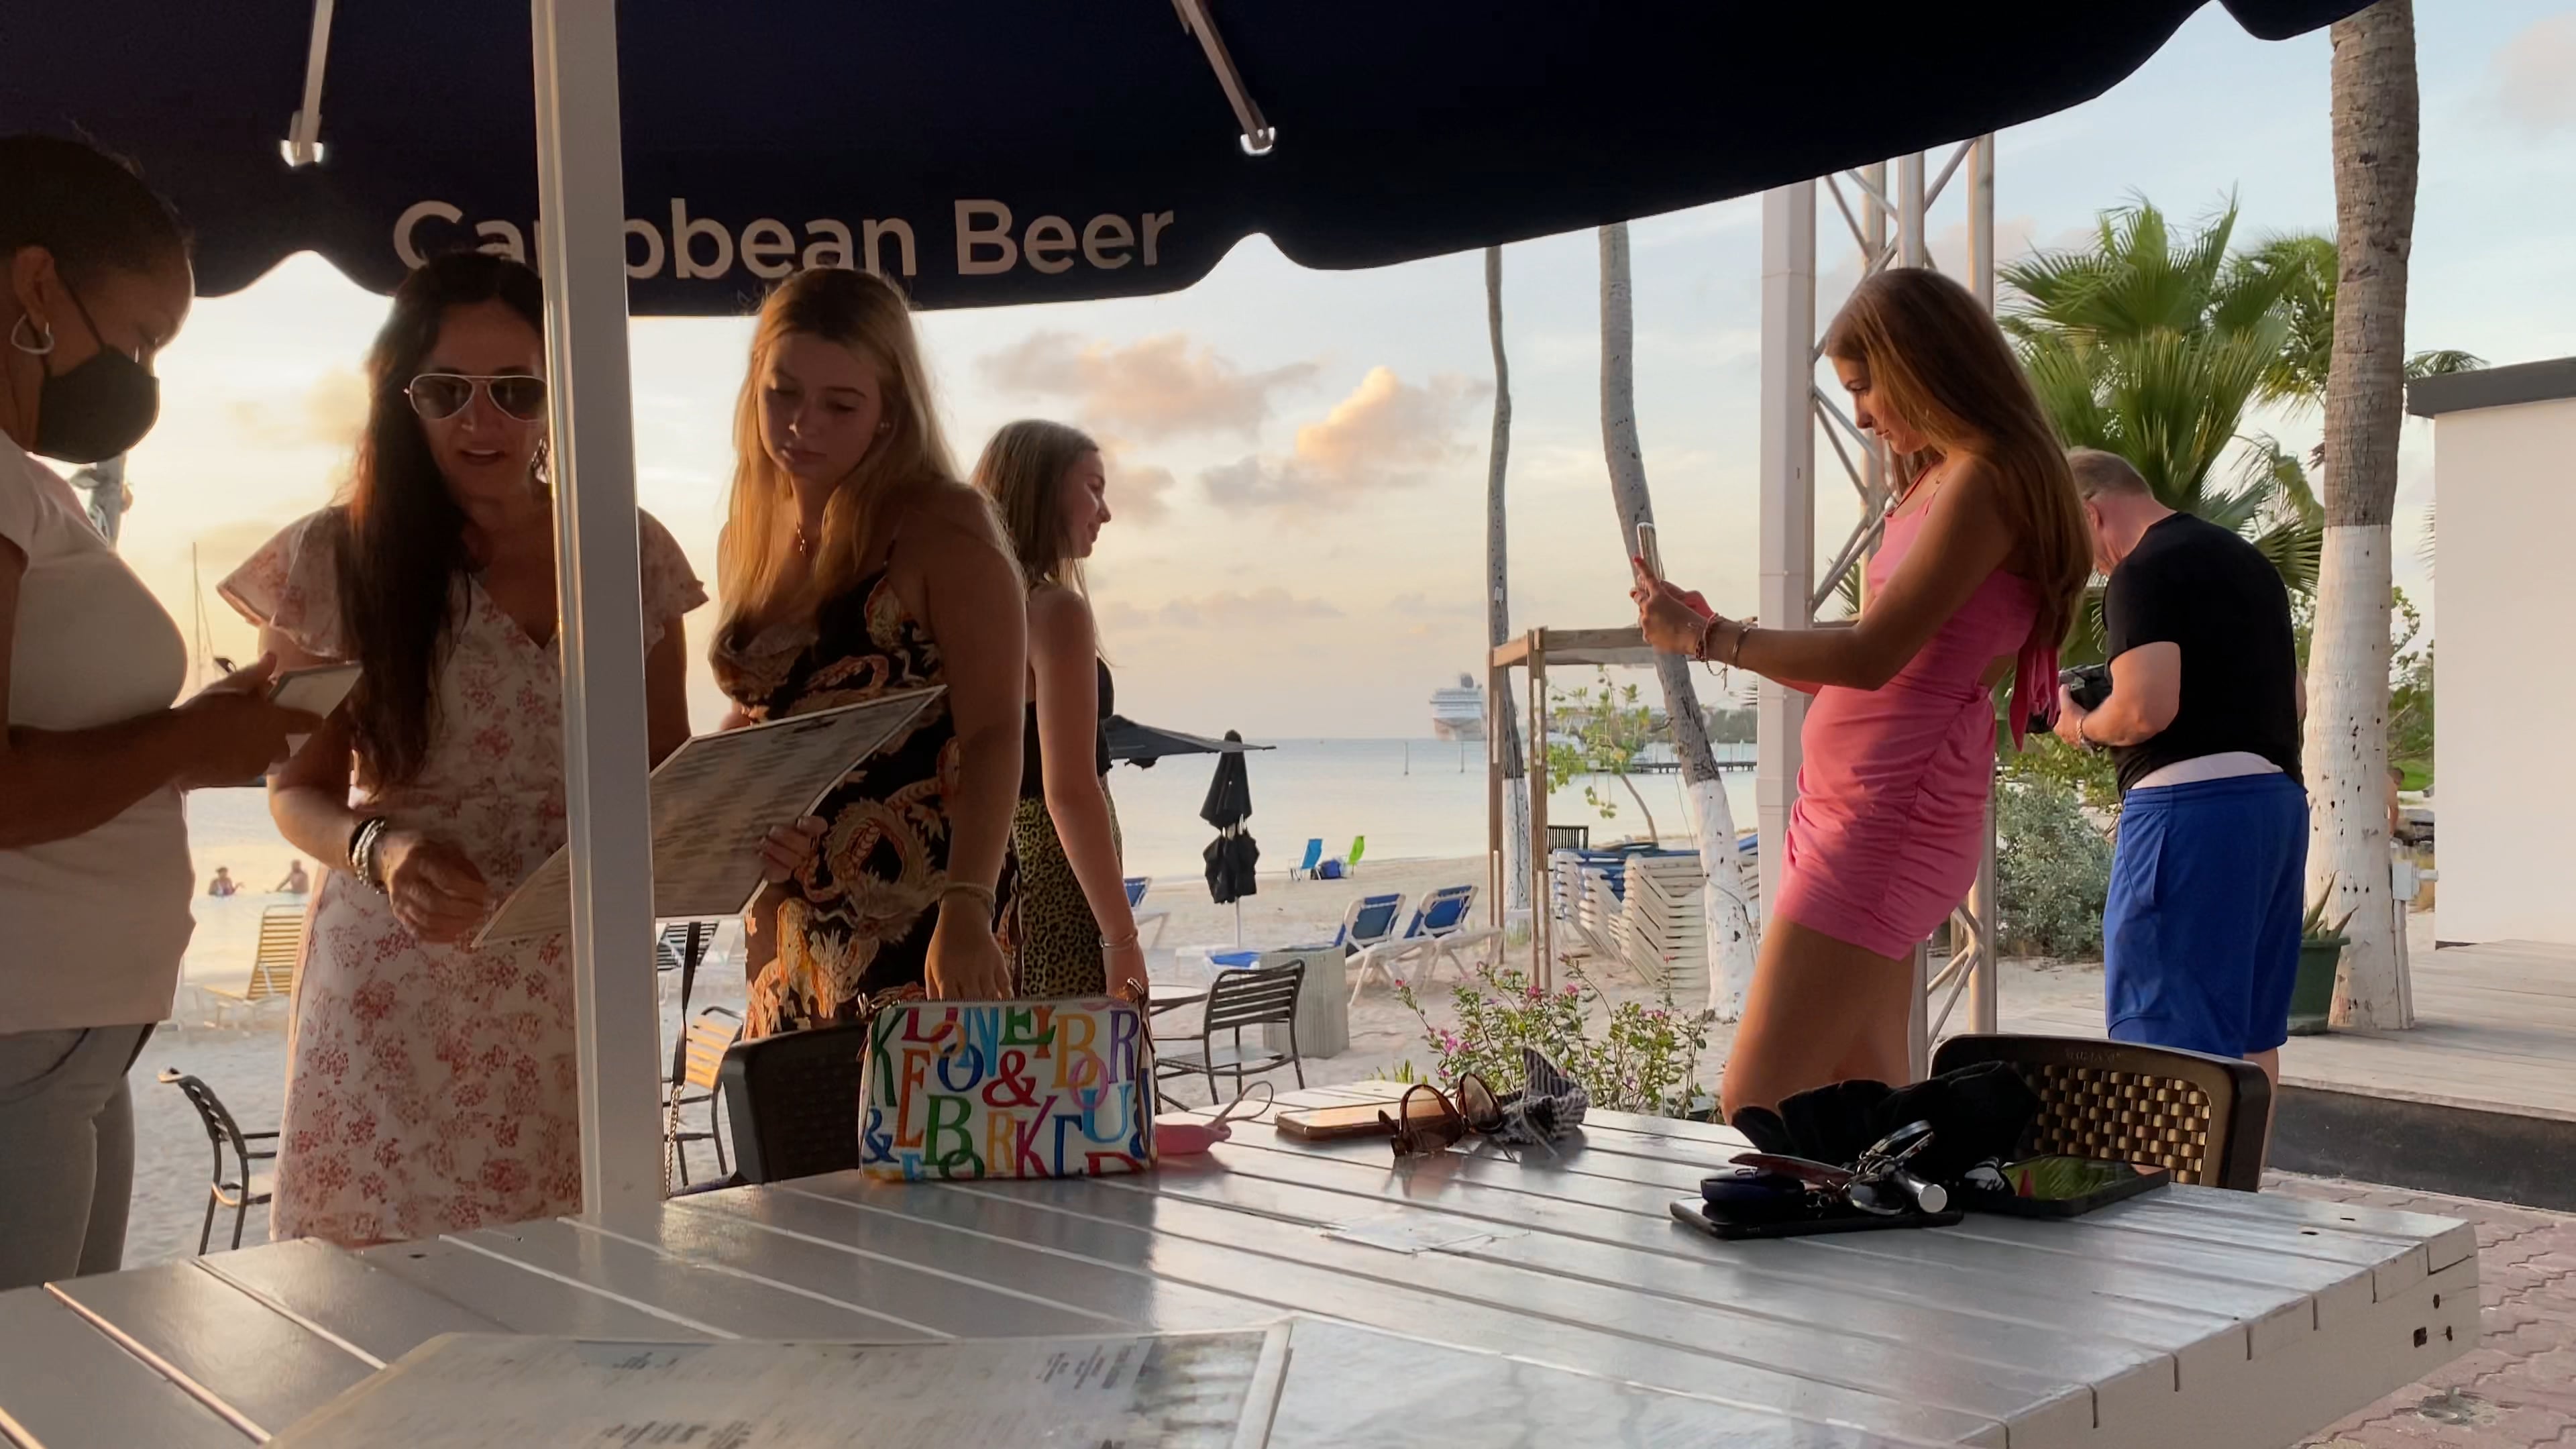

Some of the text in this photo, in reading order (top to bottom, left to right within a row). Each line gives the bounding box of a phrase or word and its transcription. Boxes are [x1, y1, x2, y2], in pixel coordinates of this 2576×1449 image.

[955, 199, 1174, 275] Beer
[1052, 1014, 1098, 1089] B
[1109, 1010, 1139, 1084] R
[894, 1048, 931, 1148] E
[936, 1043, 984, 1092] O
[982, 1050, 1040, 1108] &
[1081, 1084, 1132, 1142] U
[923, 1094, 973, 1166] B
[1016, 1095, 1058, 1179] K
